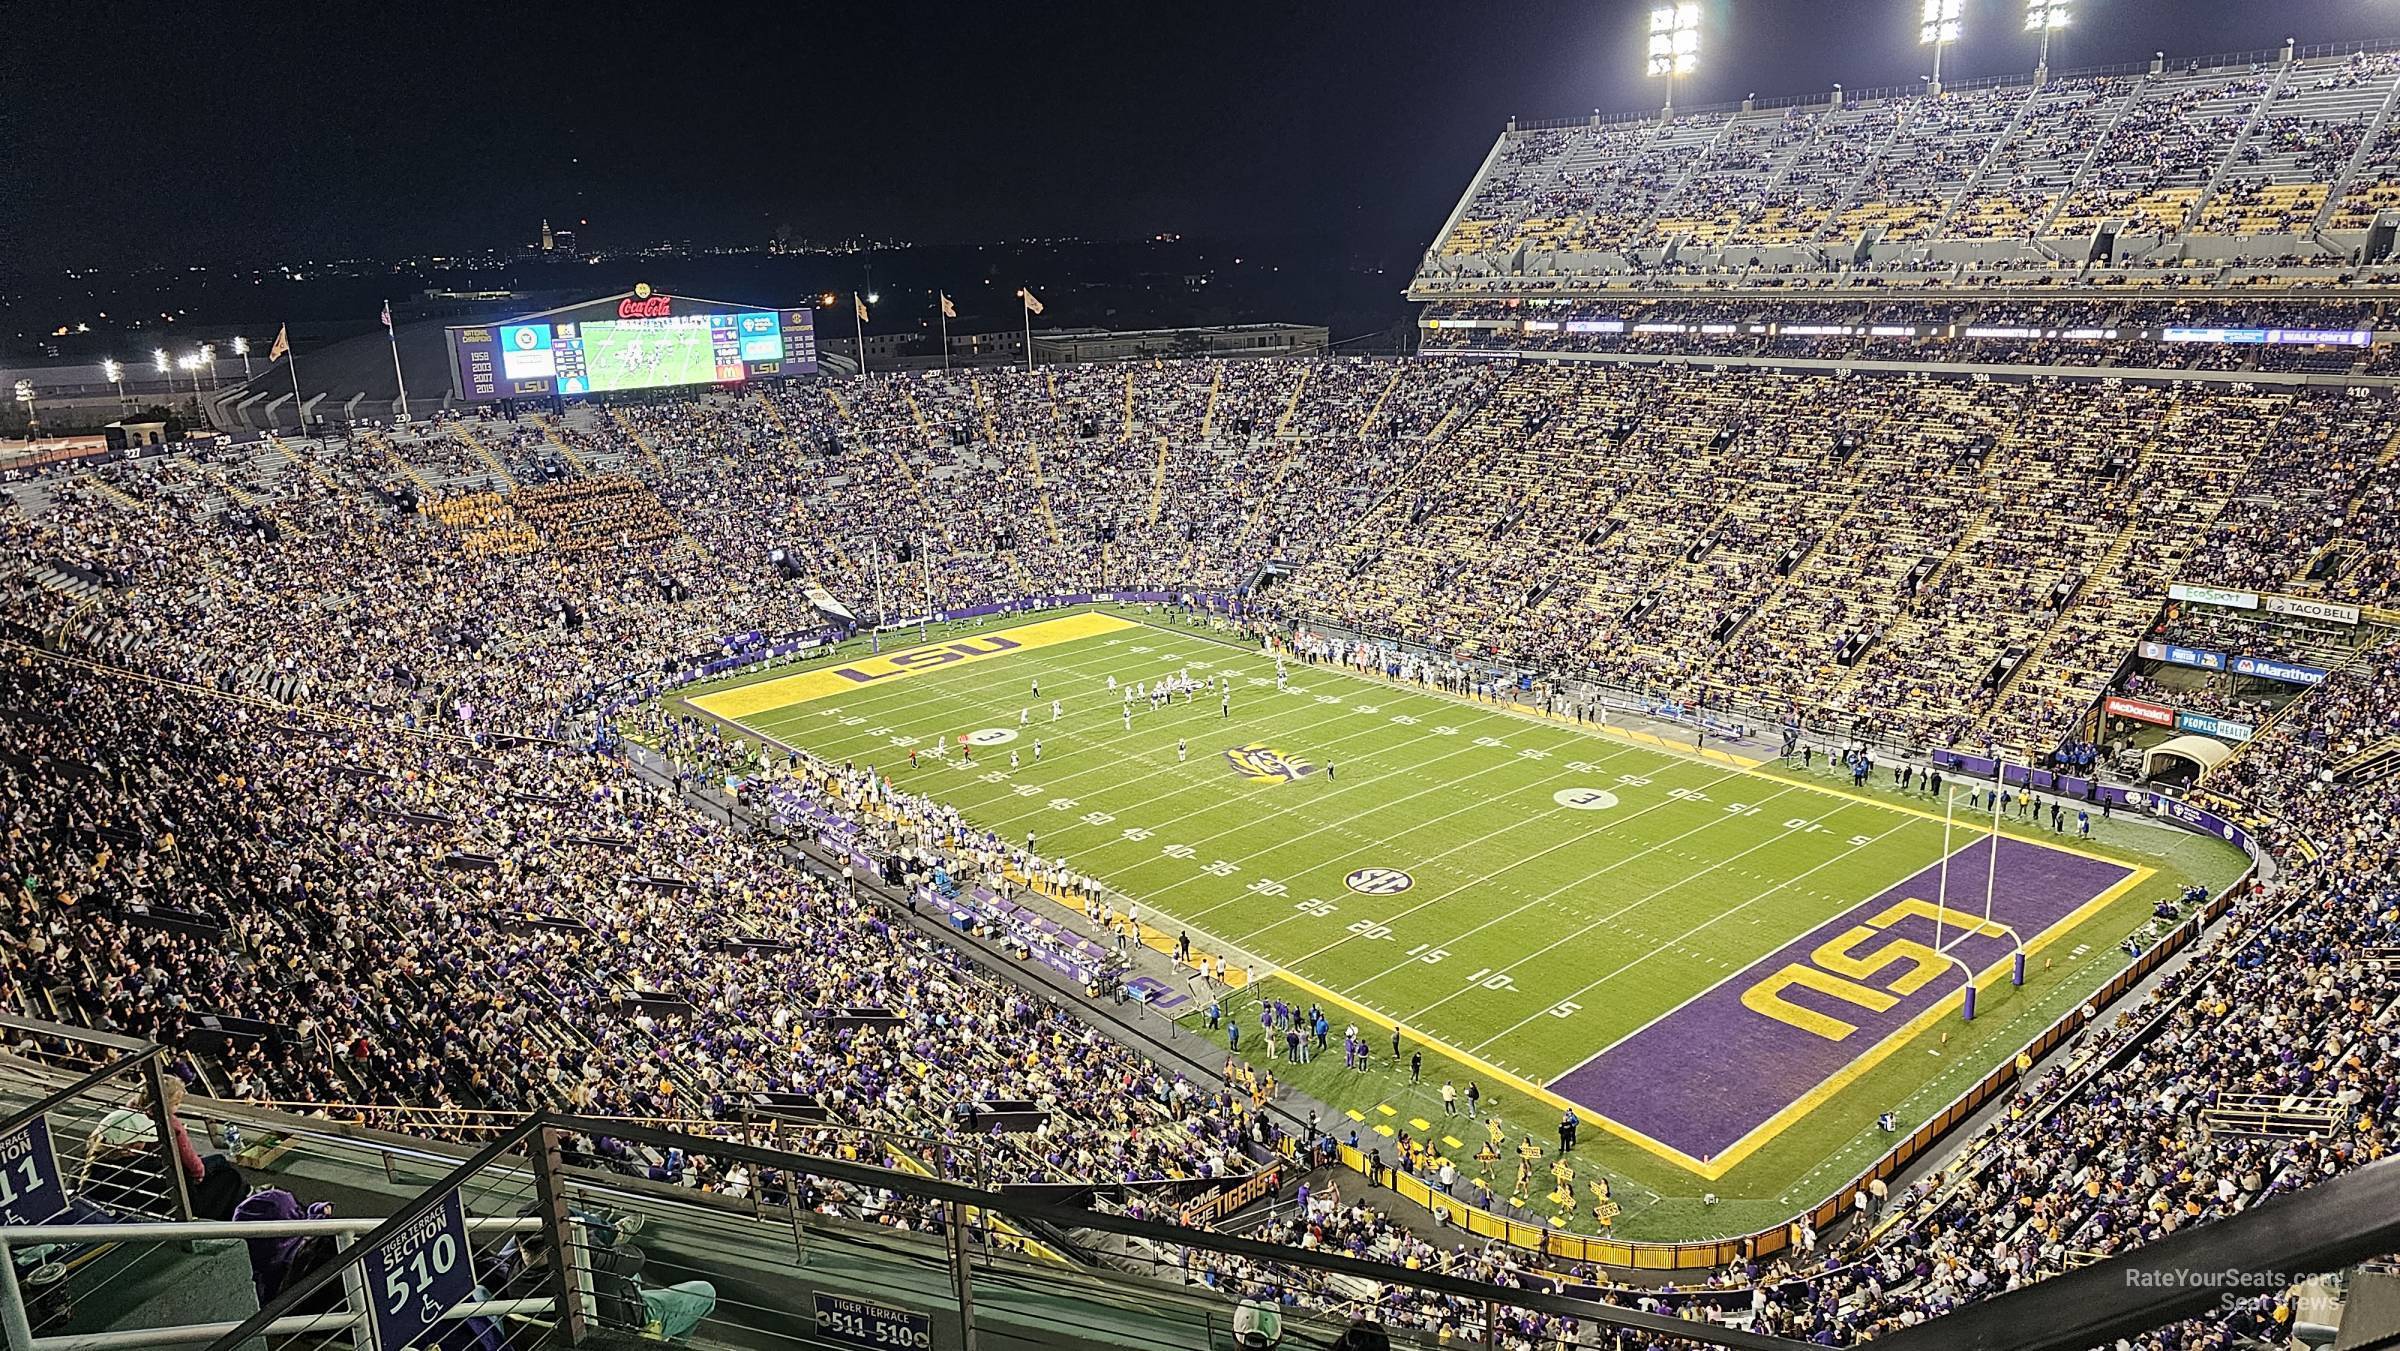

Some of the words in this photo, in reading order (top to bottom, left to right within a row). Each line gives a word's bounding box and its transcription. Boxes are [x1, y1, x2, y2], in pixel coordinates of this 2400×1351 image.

[471, 351, 490, 361] 1958
[1547, 359, 1559, 367] 300
[472, 363, 491, 372] 2003
[750, 363, 779, 375] LSU
[1836, 368, 1852, 377] 303
[474, 373, 493, 383] 2007
[1972, 373, 1990, 382] 304
[2102, 377, 2122, 387] 305
[476, 383, 494, 394] 2019
[514, 380, 549, 394] LSU
[2347, 387, 2370, 397] 410
[2185, 587, 2239, 602] EcoSport
[2289, 602, 2321, 615] TACO
[2324, 608, 2353, 620] BELL
[833, 637, 1022, 683] LSU
[2256, 662, 2323, 682] Marathon
[2109, 702, 2171, 721] McDonald's
[2183, 716, 2217, 732] PEOPLES
[2219, 721, 2250, 739] HEALTH
[1569, 792, 1601, 805] 3
[1080, 811, 1117, 826] 50
[1121, 827, 1156, 842] 45
[1846, 835, 1873, 846] 5
[1161, 844, 1197, 859] 40
[1200, 860, 1242, 877] 35
[1246, 878, 1288, 897] 30
[1347, 868, 1412, 895] SEC
[1294, 898, 1339, 918] 25
[1346, 918, 1390, 940] 20
[1405, 943, 1451, 965] 15
[1741, 898, 2012, 1042] LSU
[1465, 968, 1514, 991] 10
[1548, 1001, 1584, 1019] 5
[1180, 1185, 1220, 1212] COME
[1215, 1179, 1266, 1217] TIGERS
[381, 1232, 407, 1256] TIGER
[408, 1203, 446, 1236] TERRACE
[383, 1214, 447, 1272] SECTION
[386, 1233, 456, 1315] 510
[834, 1299, 861, 1313] TIGER
[865, 1306, 910, 1323] TERRACE
[832, 1311, 866, 1337] 511
[876, 1321, 912, 1347] 510
